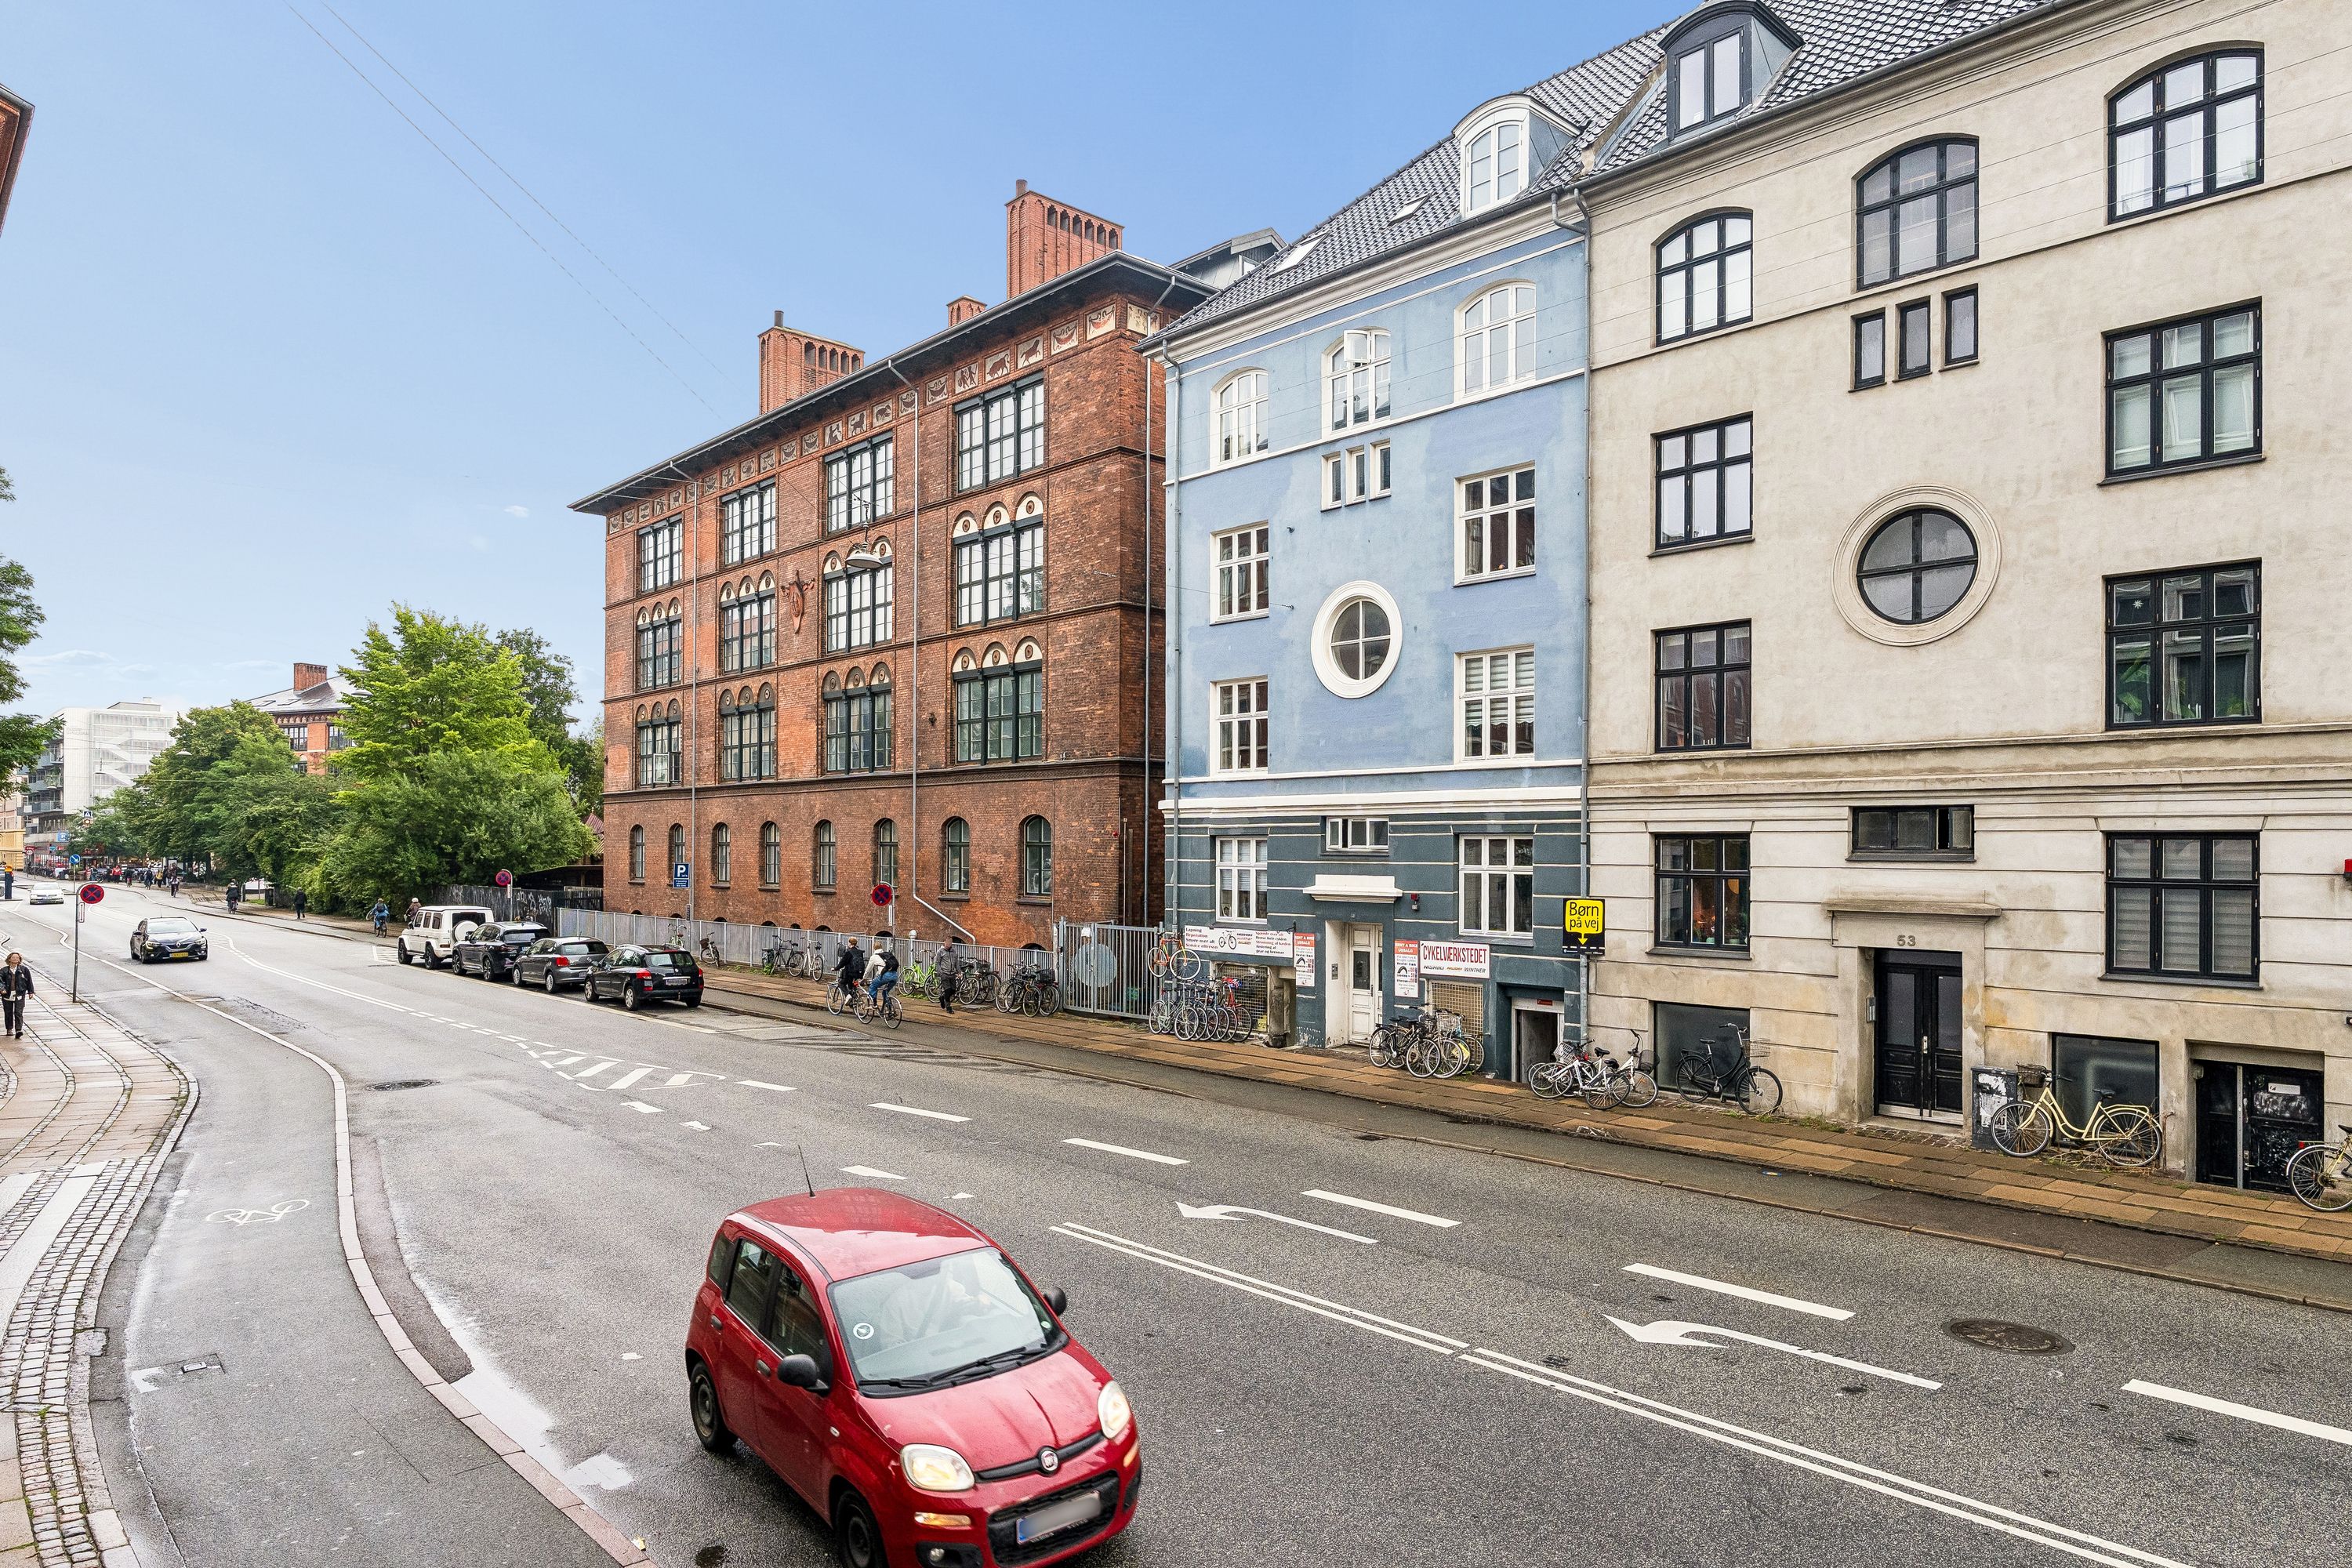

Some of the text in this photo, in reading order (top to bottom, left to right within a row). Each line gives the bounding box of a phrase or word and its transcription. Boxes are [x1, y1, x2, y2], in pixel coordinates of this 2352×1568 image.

[677, 865, 686, 877] P
[1570, 902, 1599, 916] Børn
[1570, 916, 1599, 931] på vej
[1897, 935, 1916, 947] 53
[1423, 945, 1487, 964] CYKELVÆRKSTEDET
